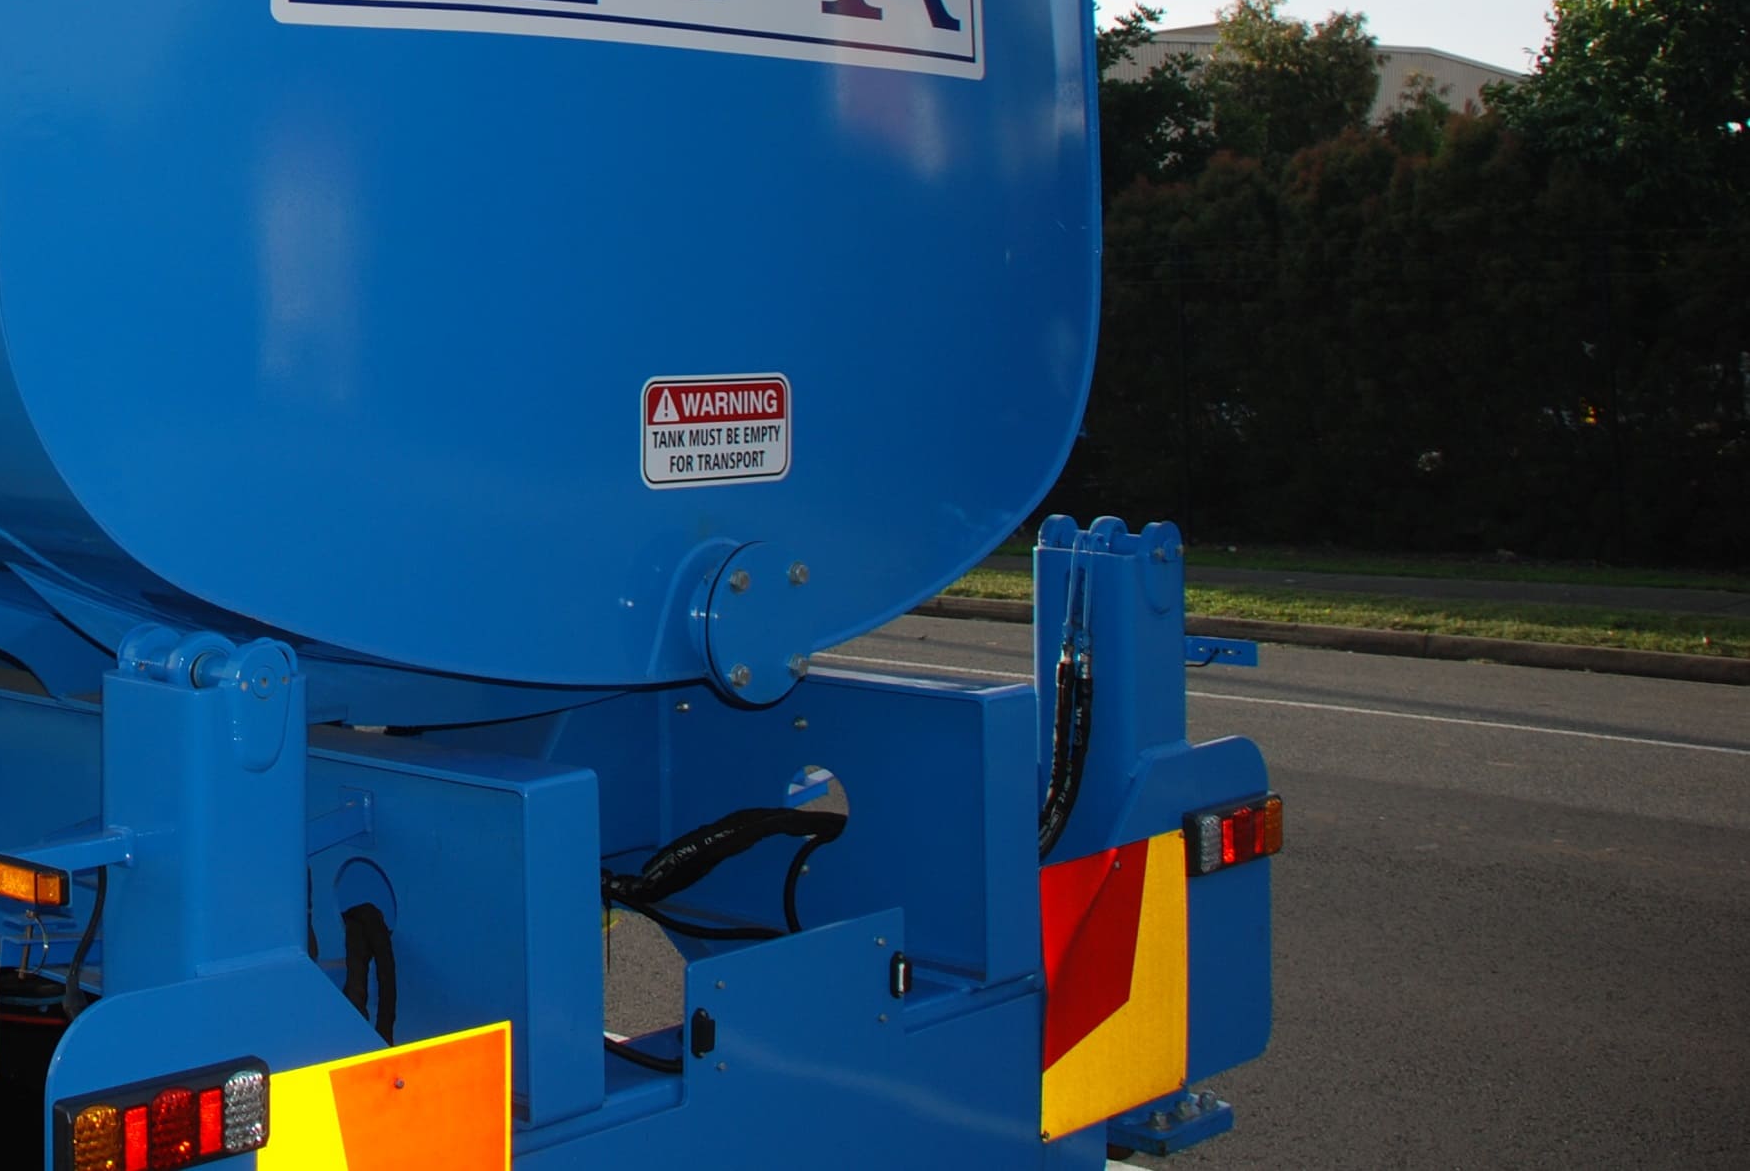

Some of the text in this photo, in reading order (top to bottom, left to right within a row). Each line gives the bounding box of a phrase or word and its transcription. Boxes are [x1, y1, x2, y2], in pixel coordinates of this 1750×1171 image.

[680, 389, 778, 417] WARNING
[652, 425, 781, 449] TANK MUST BE EMPTY
[669, 450, 765, 473] FOR TRANSPORT
